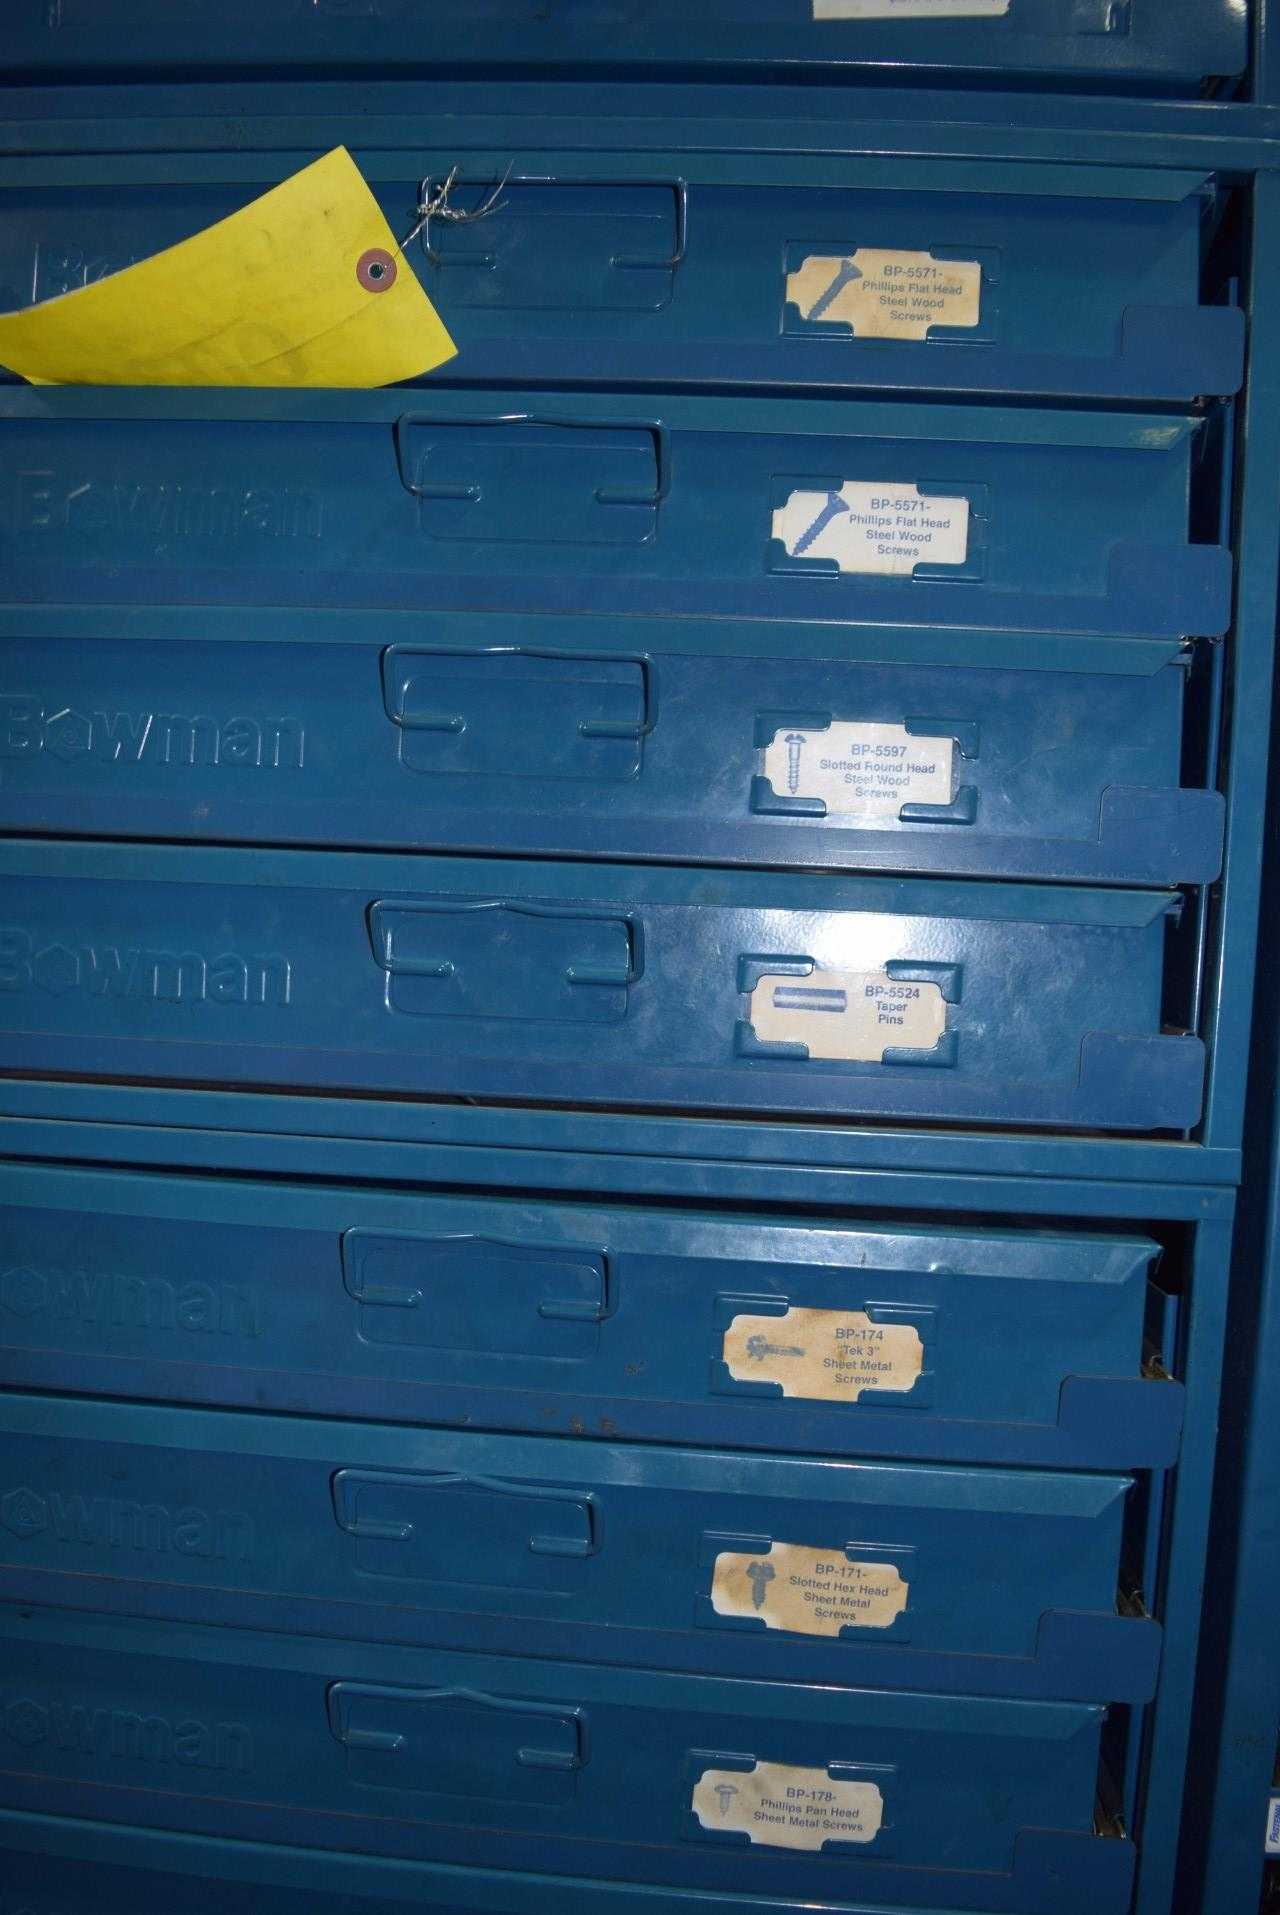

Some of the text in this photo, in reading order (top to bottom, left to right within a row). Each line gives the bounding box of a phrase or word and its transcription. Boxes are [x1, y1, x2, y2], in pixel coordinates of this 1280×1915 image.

[883, 265, 943, 278] BP-5571-
[862, 280, 963, 295] Phillips Flat Head
[879, 295, 945, 308] Steel Wood
[890, 310, 932, 321] Screws
[871, 498, 930, 511] BP-5571-
[849, 514, 951, 529] Phillips Flat Head
[866, 529, 932, 542] Steel Wood
[877, 544, 920, 556] Screws
[851, 744, 908, 757] BP-5597
[820, 760, 936, 774] Slotted Round Head
[844, 773, 911, 786] Steel Wood
[855, 787, 899, 799] Screws
[865, 985, 920, 999] BP-5524
[876, 1001, 908, 1014] Taper
[878, 1014, 904, 1025] Pins
[835, 1327, 884, 1341] BP-174
[823, 1357, 893, 1371] Sheet Metal
[834, 1372, 879, 1385] Screws
[815, 1563, 867, 1579] BP-171-
[789, 1575, 889, 1597] Slotted Hex Head
[804, 1591, 871, 1609] Sheet Metal
[814, 1607, 856, 1621] Screws
[760, 1798, 860, 1819] Phillips Pan Head
[753, 1811, 863, 1832] Sheet Metal Screws
